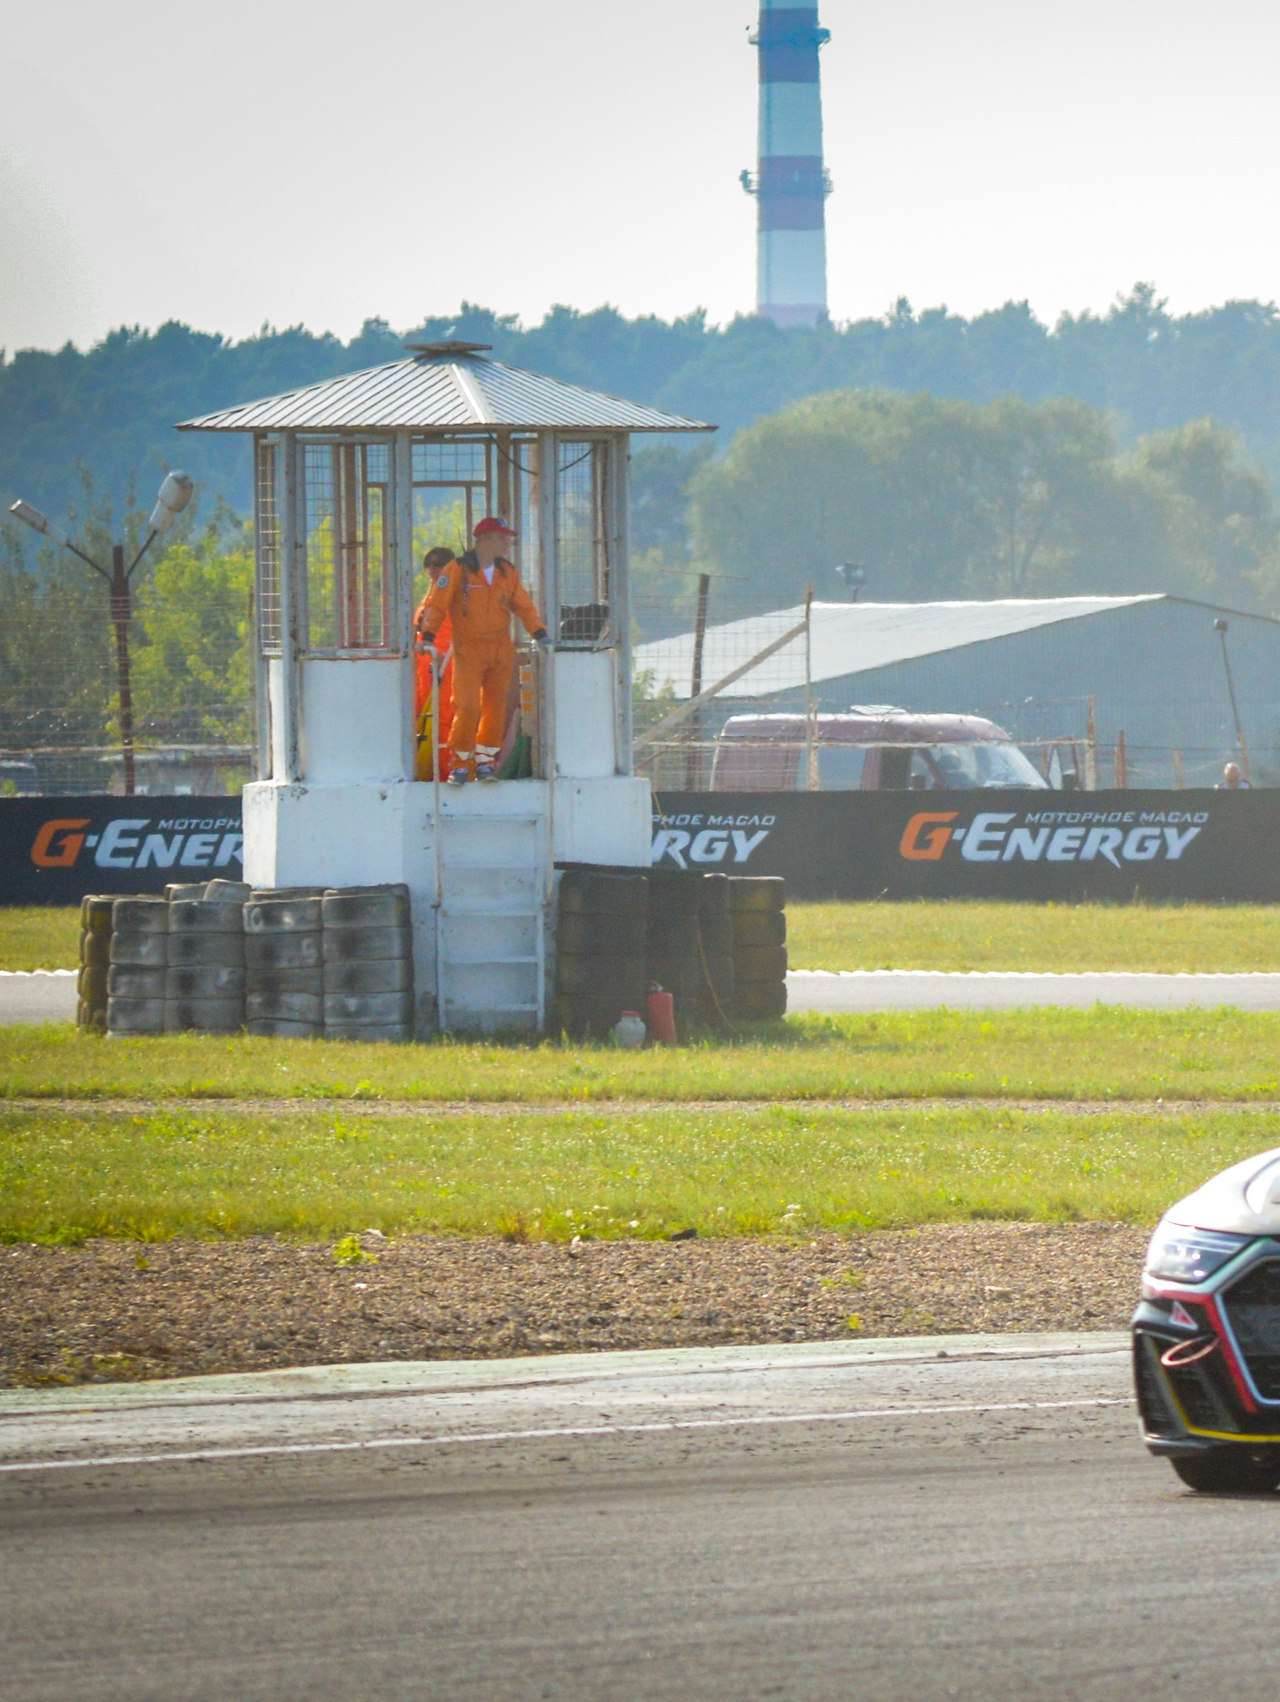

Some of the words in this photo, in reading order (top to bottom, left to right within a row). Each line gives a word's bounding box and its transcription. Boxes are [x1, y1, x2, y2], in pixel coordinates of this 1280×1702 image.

[707, 814, 776, 826] МАСЛО
[1024, 811, 1134, 823] МОТОРНОЕ
[1139, 811, 1209, 823] МАСЛО
[158, 818, 243, 830] МОТОРН
